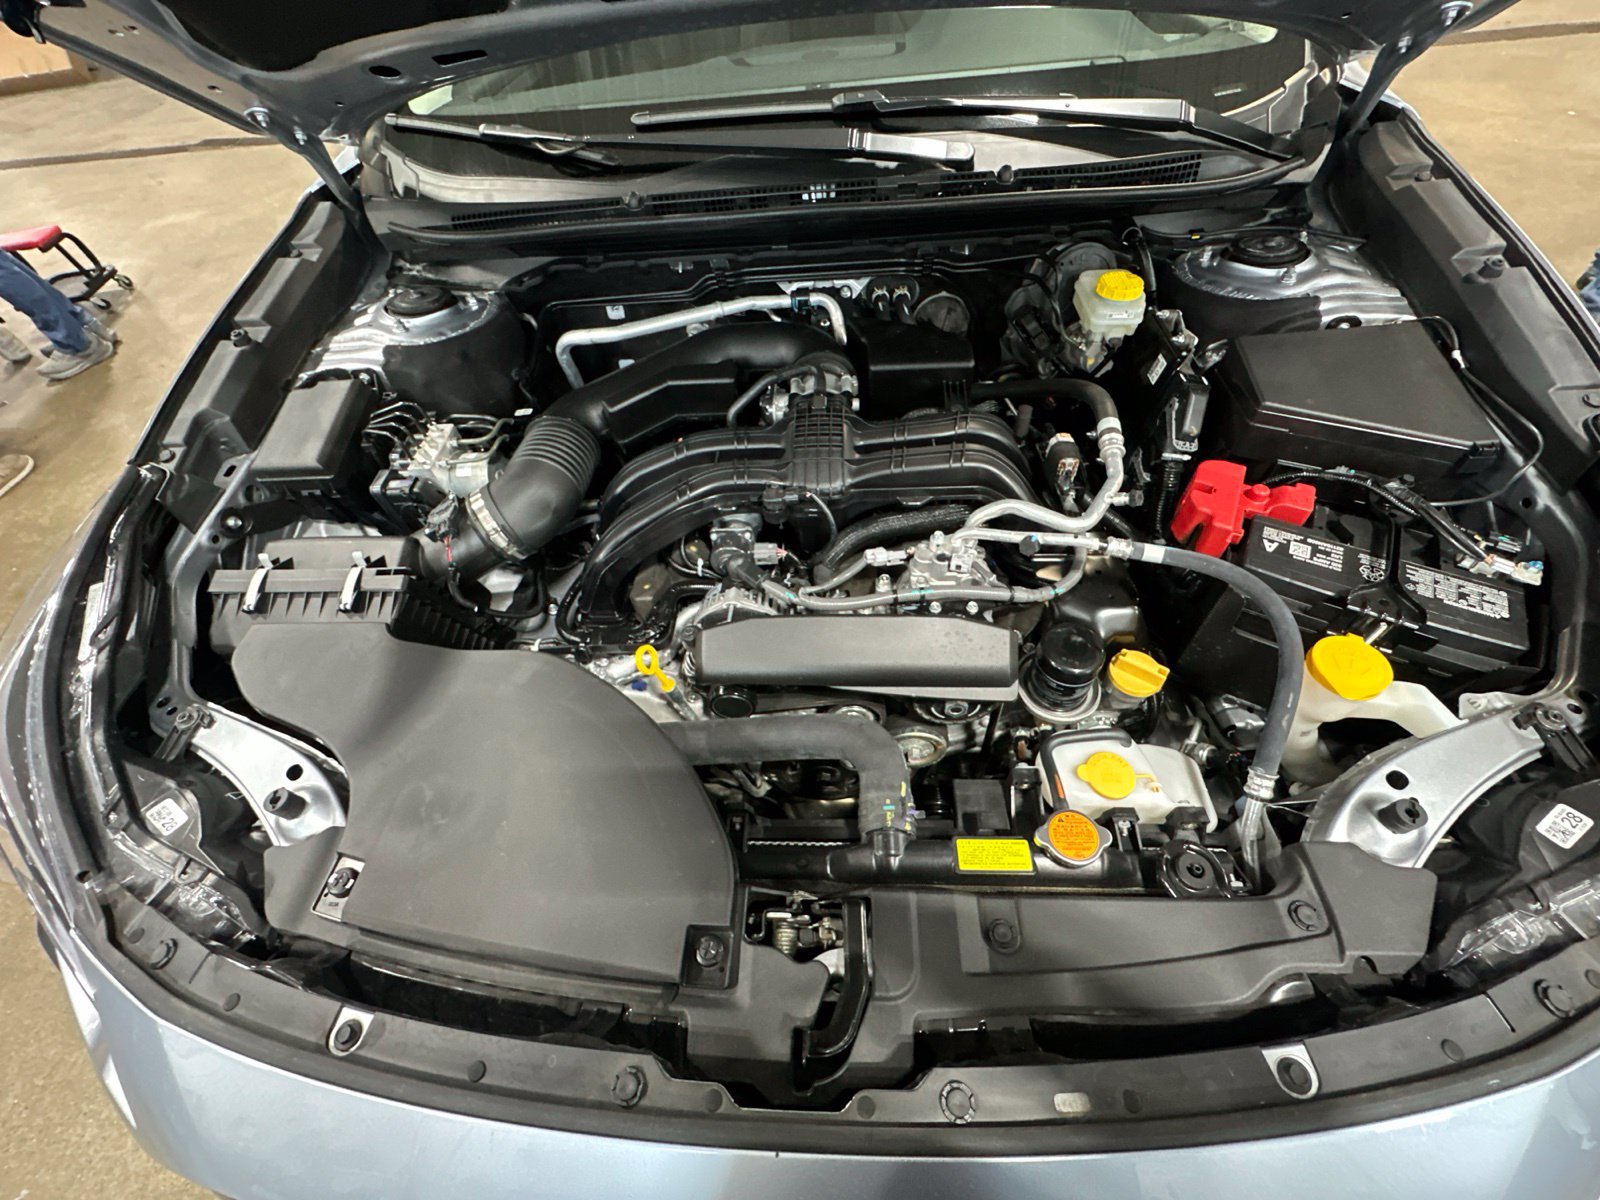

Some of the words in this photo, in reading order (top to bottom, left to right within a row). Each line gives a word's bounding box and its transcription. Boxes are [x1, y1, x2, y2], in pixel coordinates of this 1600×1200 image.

[1262, 539, 1280, 553] A
[161, 817, 178, 832] 28
[1561, 811, 1583, 829] 28
